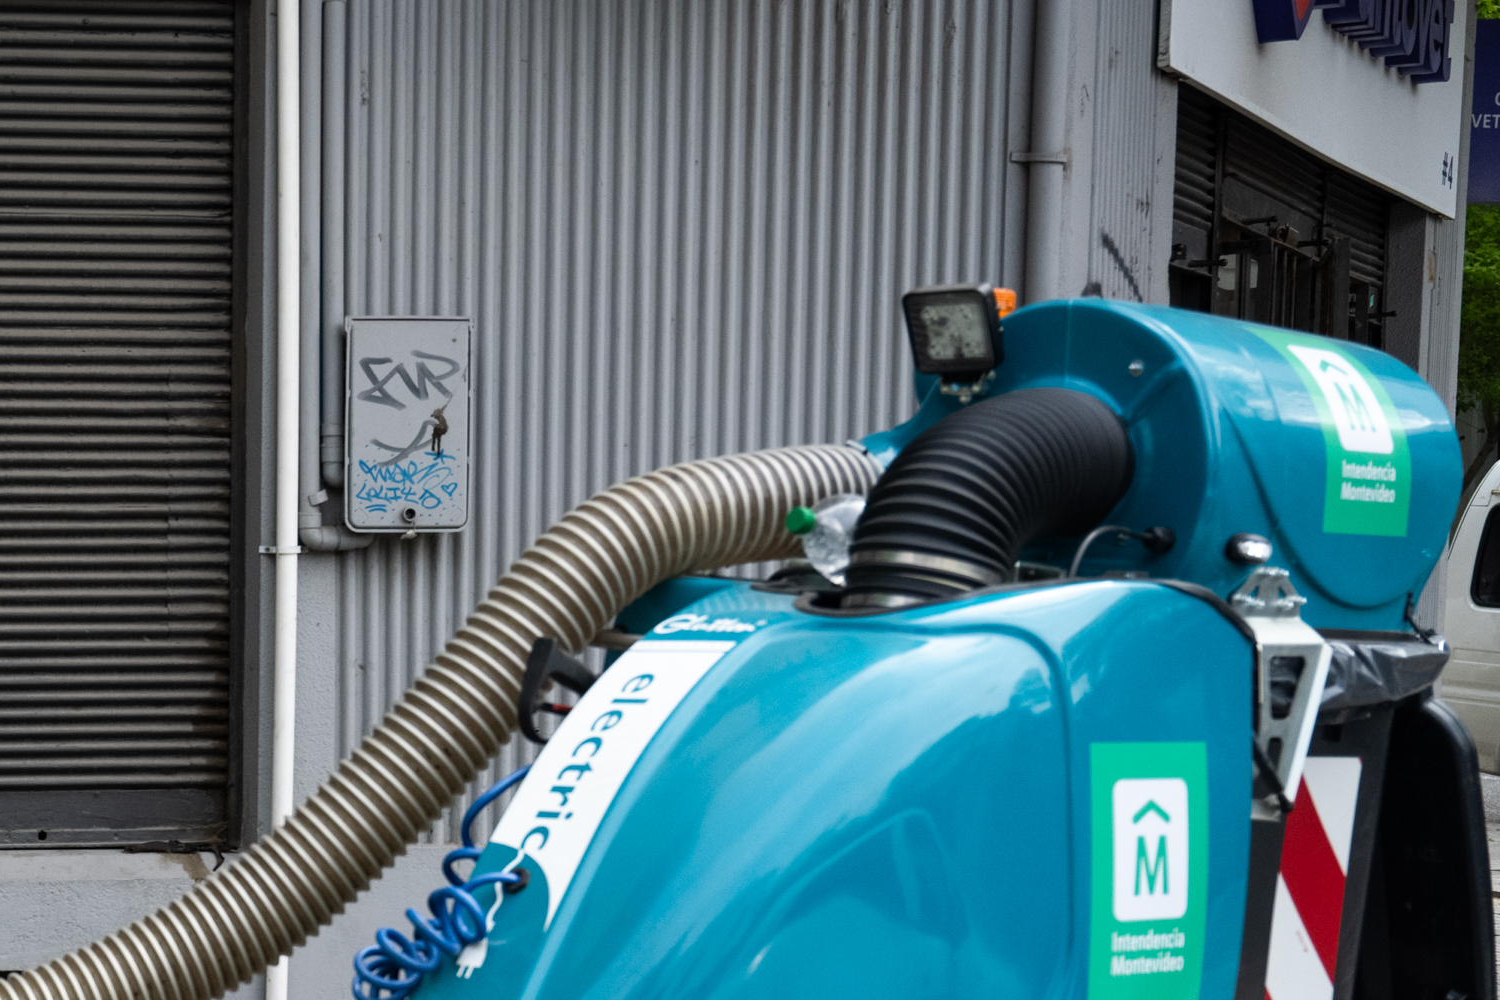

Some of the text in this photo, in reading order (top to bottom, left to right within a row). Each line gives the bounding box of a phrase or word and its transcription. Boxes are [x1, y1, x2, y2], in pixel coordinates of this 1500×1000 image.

[1341, 459, 1396, 482] Intendencia
[1340, 480, 1396, 503] Montevideo
[520, 673, 654, 851] electric
[1111, 927, 1185, 953] Intendencia
[1110, 952, 1184, 977] Montevideo
